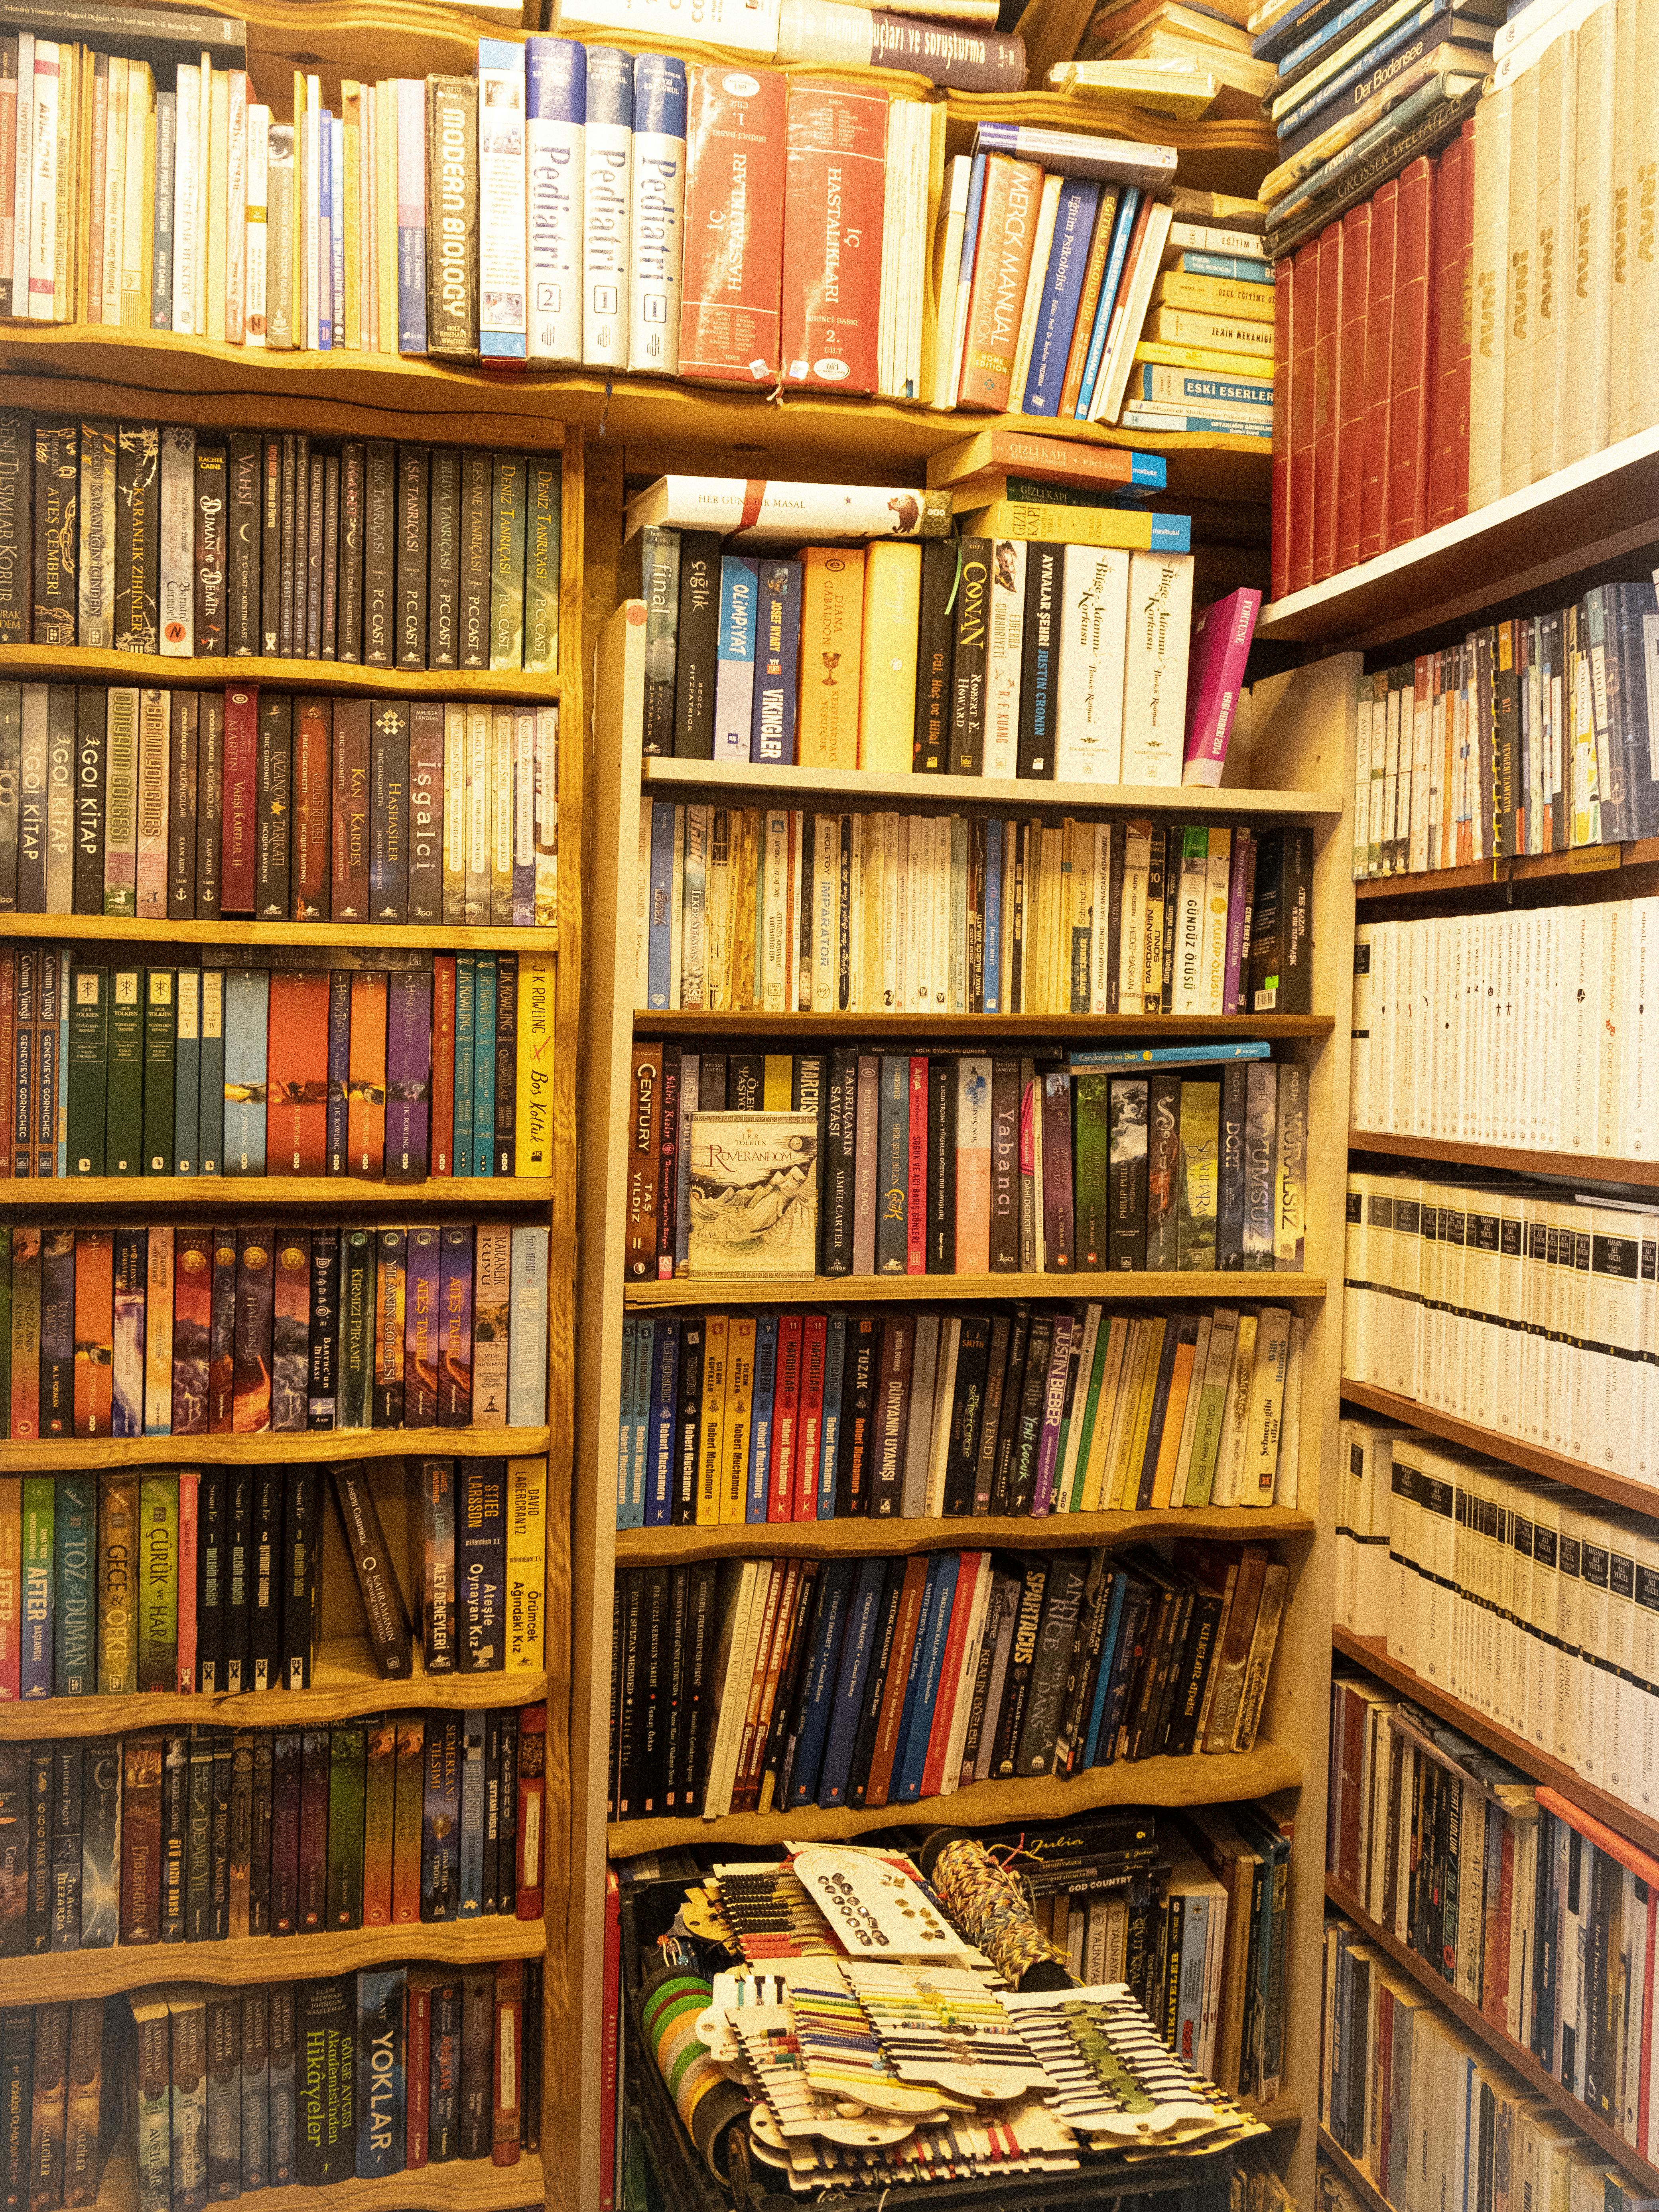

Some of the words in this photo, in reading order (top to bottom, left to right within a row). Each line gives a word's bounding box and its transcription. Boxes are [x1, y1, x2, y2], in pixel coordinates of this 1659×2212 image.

[908, 30, 921, 52] ve
[925, 33, 985, 69] soruşturma
[1354, 83, 1372, 103] Der
[1373, 42, 1423, 88] Bodensee
[443, 108, 465, 209] MODERN
[161, 172, 169, 196] PROJE
[533, 146, 571, 270] Pediatri
[589, 146, 626, 273] Pediatri
[639, 156, 677, 283] Pediatri
[728, 153, 747, 291] HASTALIKLARI
[1003, 170, 1031, 248] MERCK
[1064, 195, 1081, 234] Eğitim
[825, 167, 842, 303] HASTALIKLARI
[1222, 236, 1249, 248] EĞİTİM
[442, 218, 466, 317] BIOLOGY
[1054, 236, 1075, 291] Psikolojisi
[543, 289, 554, 306] 2
[602, 292, 609, 307] 1
[652, 301, 659, 317] 1
[991, 250, 1023, 347] MANUAL
[826, 330, 839, 343] 2.
[1187, 382, 1216, 394] ESKİ
[405, 457, 418, 481] AŞK
[1040, 447, 1066, 461] KAPI
[440, 461, 452, 500] TRUVA
[47, 487, 59, 525] ATEŞ
[132, 488, 144, 561] KARANLIK
[407, 487, 419, 553] TANRIÇASI
[773, 498, 806, 509] MASAL
[439, 505, 452, 570] TANRIÇASI
[471, 510, 483, 571] TANRIÇASI
[500, 510, 514, 574] TANRIÇASI
[46, 528, 61, 595] ÇEMBERİ
[1040, 554, 1054, 609] AYNALAR
[131, 566, 144, 631] ZİHİNLER
[651, 563, 672, 615] final
[406, 616, 418, 647] CAST
[498, 618, 510, 649] CAST
[771, 600, 782, 625] JOSEF
[822, 580, 832, 646] GABALDON
[833, 595, 844, 634] DIANA
[1009, 614, 1021, 650] EJDERHA
[1038, 612, 1052, 647] ŞEHRİ
[769, 627, 782, 652] NYARY
[1036, 649, 1048, 690] JUSTIN
[995, 714, 1009, 745] KUANG
[1034, 692, 1047, 737] CRONIN
[53, 748, 69, 787] GO!
[82, 749, 98, 788] GO!
[351, 768, 365, 798] KAN
[23, 805, 43, 860] KİTAP
[51, 799, 71, 854] KİTAP
[81, 800, 101, 854] KİTAP
[350, 813, 365, 867] KARDEŞ
[824, 826, 832, 853] EROL
[1151, 873, 1161, 883] 10
[819, 881, 831, 968] İMPARATOR
[1185, 899, 1199, 947] GÜNDÜZ
[1610, 912, 1618, 972] BERNARD
[1153, 930, 1162, 963] SONU
[1183, 952, 1197, 991] ÖLÜSÜ
[500, 988, 513, 1030] ROWLING
[637, 1062, 657, 1152] CENTURY
[1291, 1071, 1299, 1101] ROTH
[830, 1086, 841, 1137] SAVAŞI
[842, 1067, 855, 1156] TANRIÇANIN
[997, 1109, 1015, 1217] Yabancı
[631, 1172, 642, 1223] YILDIZ
[643, 1183, 653, 1212] TAŞ
[834, 1205, 843, 1248] CARTER
[493, 1236, 507, 1286] KARANLIK
[351, 1268, 363, 1316] KIRMIZI
[384, 1259, 397, 1319] YILANIN
[416, 1277, 428, 1314] ATEŞ
[416, 1318, 428, 1360] TAHTI
[1052, 1326, 1073, 1375] JUSTIN
[856, 1348, 871, 1389] TUZAK
[885, 1381, 903, 1437] DÜNYANIN
[1045, 1376, 1065, 1427] BIEBER
[660, 1422, 670, 1450] Robert
[782, 1418, 792, 1445] Robert
[826, 1417, 837, 1444] Robert
[656, 1451, 669, 1501] Muchamore
[778, 1446, 791, 1496] Muchamore
[824, 1445, 836, 1494] Muchamore
[468, 1476, 483, 1529] LARSSON
[484, 1484, 499, 1518] STIEG
[514, 1471, 527, 1535] LAGERCRANTZ
[528, 1489, 540, 1516] DAVID
[64, 1537, 88, 1581] TOZ
[107, 1545, 128, 1592] GECE
[146, 1527, 173, 1585] ÇÜRÜK
[433, 1562, 447, 1589] ALEV
[27, 1566, 48, 1621] AFTER
[71, 1585, 82, 1595] &
[112, 1595, 124, 1605] &
[469, 1563, 483, 1622] Oynayan
[483, 1583, 497, 1626] Ateşle
[512, 1582, 524, 1631] Ağındaki
[64, 1597, 87, 1666] DUMAN
[106, 1609, 132, 1660] ÖFKE
[433, 1592, 450, 1651] DENEYLERİ
[469, 1625, 483, 1648] Kız
[527, 1591, 542, 1643] Örümcek
[512, 1635, 524, 1654] Kız
[172, 1769, 180, 1802] RACHEL
[444, 1724, 456, 1804] SEMERKANT
[171, 1804, 180, 1832] CAINE
[37, 1842, 45, 1865] PARK
[168, 1839, 182, 1858] ÖLÜ
[1030, 1836, 1084, 1856] Julia
[36, 1868, 45, 1912] BULVARI
[168, 1861, 181, 1886] KIZIN
[1068, 1881, 1088, 1893] GOD
[1090, 1875, 1133, 1889] COUNTRY
[168, 1890, 180, 1917] DANSI
[341, 2037, 353, 2080] GÖLGE
[299, 2029, 325, 2148] Hikâyeler
[341, 2084, 352, 2129] AVCISI
[370, 2029, 394, 2150] YOKLAR
